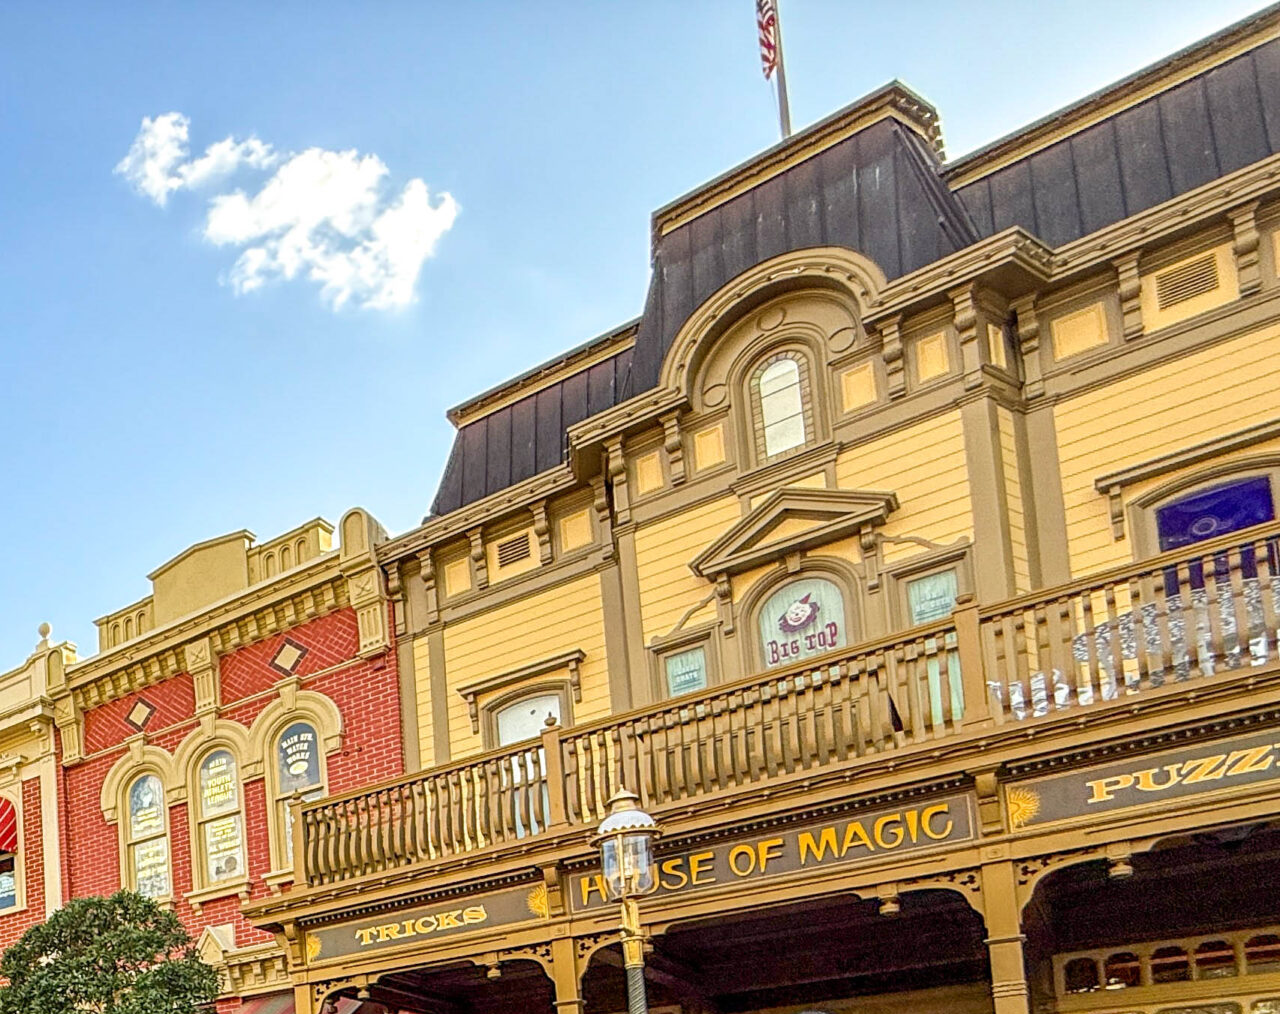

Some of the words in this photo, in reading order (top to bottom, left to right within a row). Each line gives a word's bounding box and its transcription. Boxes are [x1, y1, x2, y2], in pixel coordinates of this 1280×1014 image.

[767, 640, 800, 665] BIG
[804, 622, 838, 651] TOP
[281, 734, 298, 749] MAIN
[286, 742, 309, 755] WATER
[286, 751, 310, 765] WORKS
[206, 774, 232, 788] YOUTH
[1086, 743, 1280, 804] PUZZ
[728, 838, 784, 877] OF
[797, 803, 954, 865] MAGIC
[354, 904, 488, 946] TRICKS
